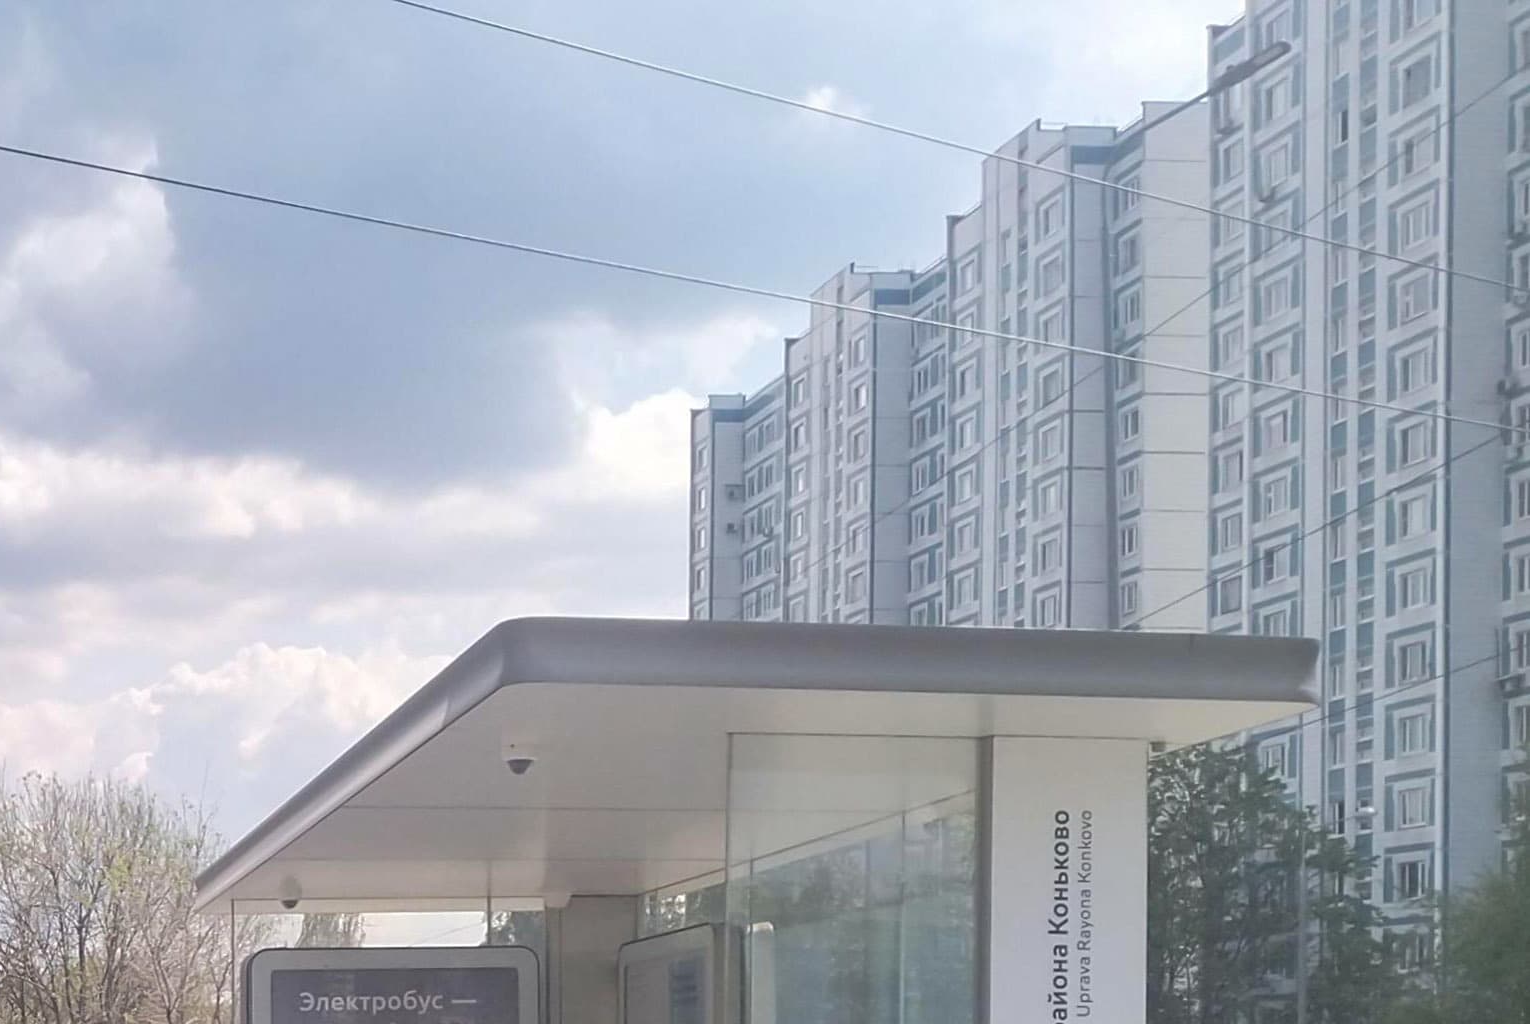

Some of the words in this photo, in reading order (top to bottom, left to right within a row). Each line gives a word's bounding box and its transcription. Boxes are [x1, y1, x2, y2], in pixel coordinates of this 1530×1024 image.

[1047, 809, 1070, 936] Коньково
[1077, 809, 1093, 884] Konkovo
[1076, 888, 1094, 952] Rayona
[298, 989, 444, 1015] Электробус
[1076, 955, 1094, 1018] Uprava
